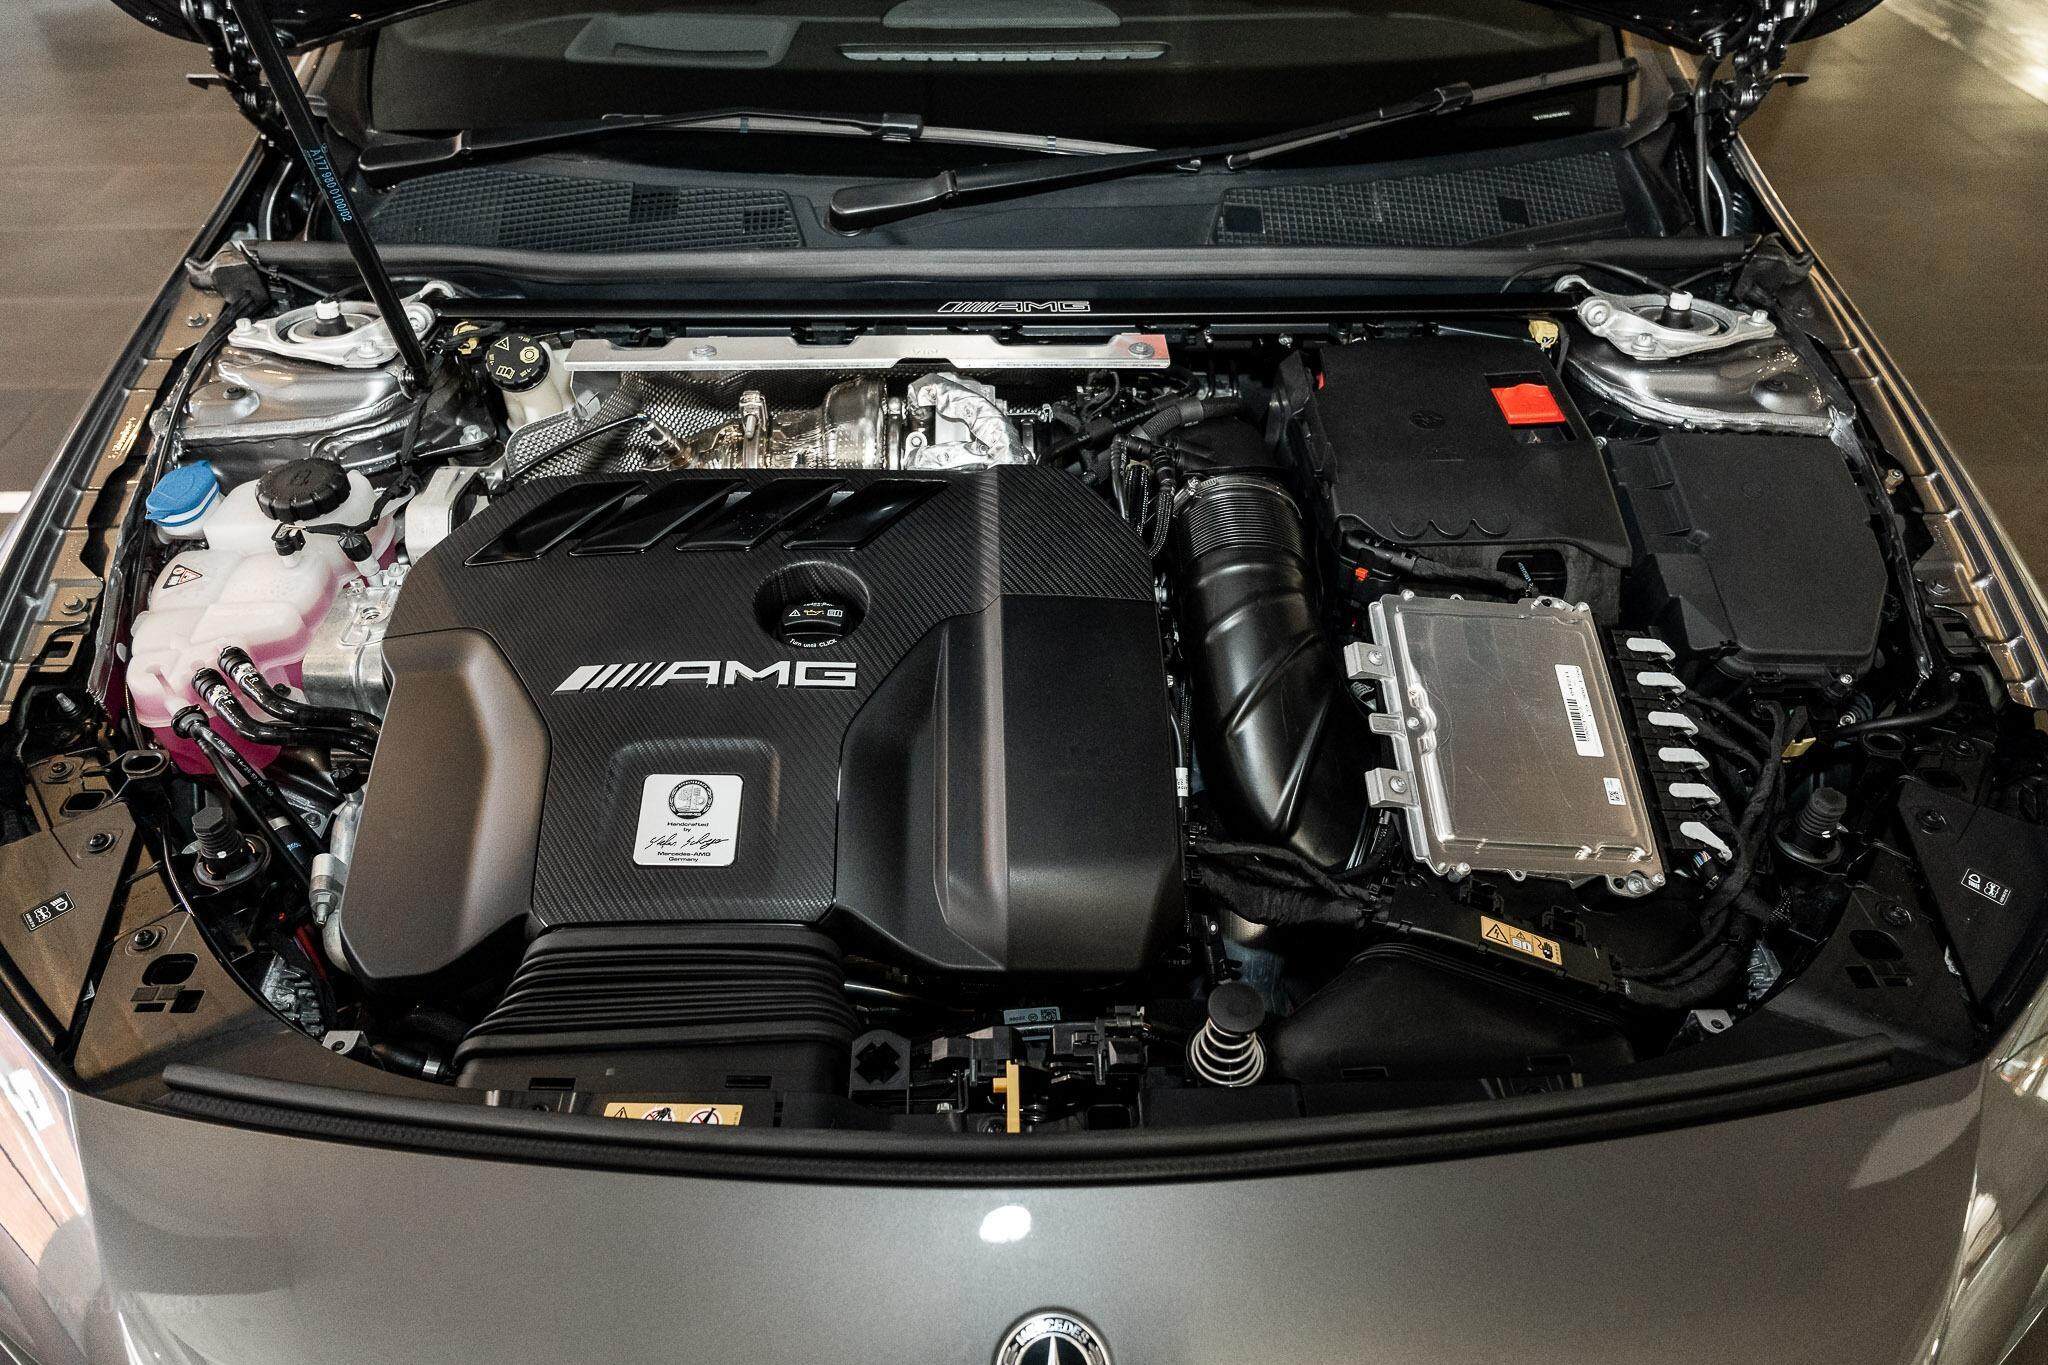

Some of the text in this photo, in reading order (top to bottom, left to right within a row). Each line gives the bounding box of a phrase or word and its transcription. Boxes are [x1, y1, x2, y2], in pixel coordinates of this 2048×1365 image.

[310, 149, 329, 170] A177
[322, 172, 337, 188] 980
[330, 189, 353, 222] 0100/02
[988, 301, 1091, 313] AMG
[818, 638, 838, 648] CLICK
[650, 660, 857, 688] AMG
